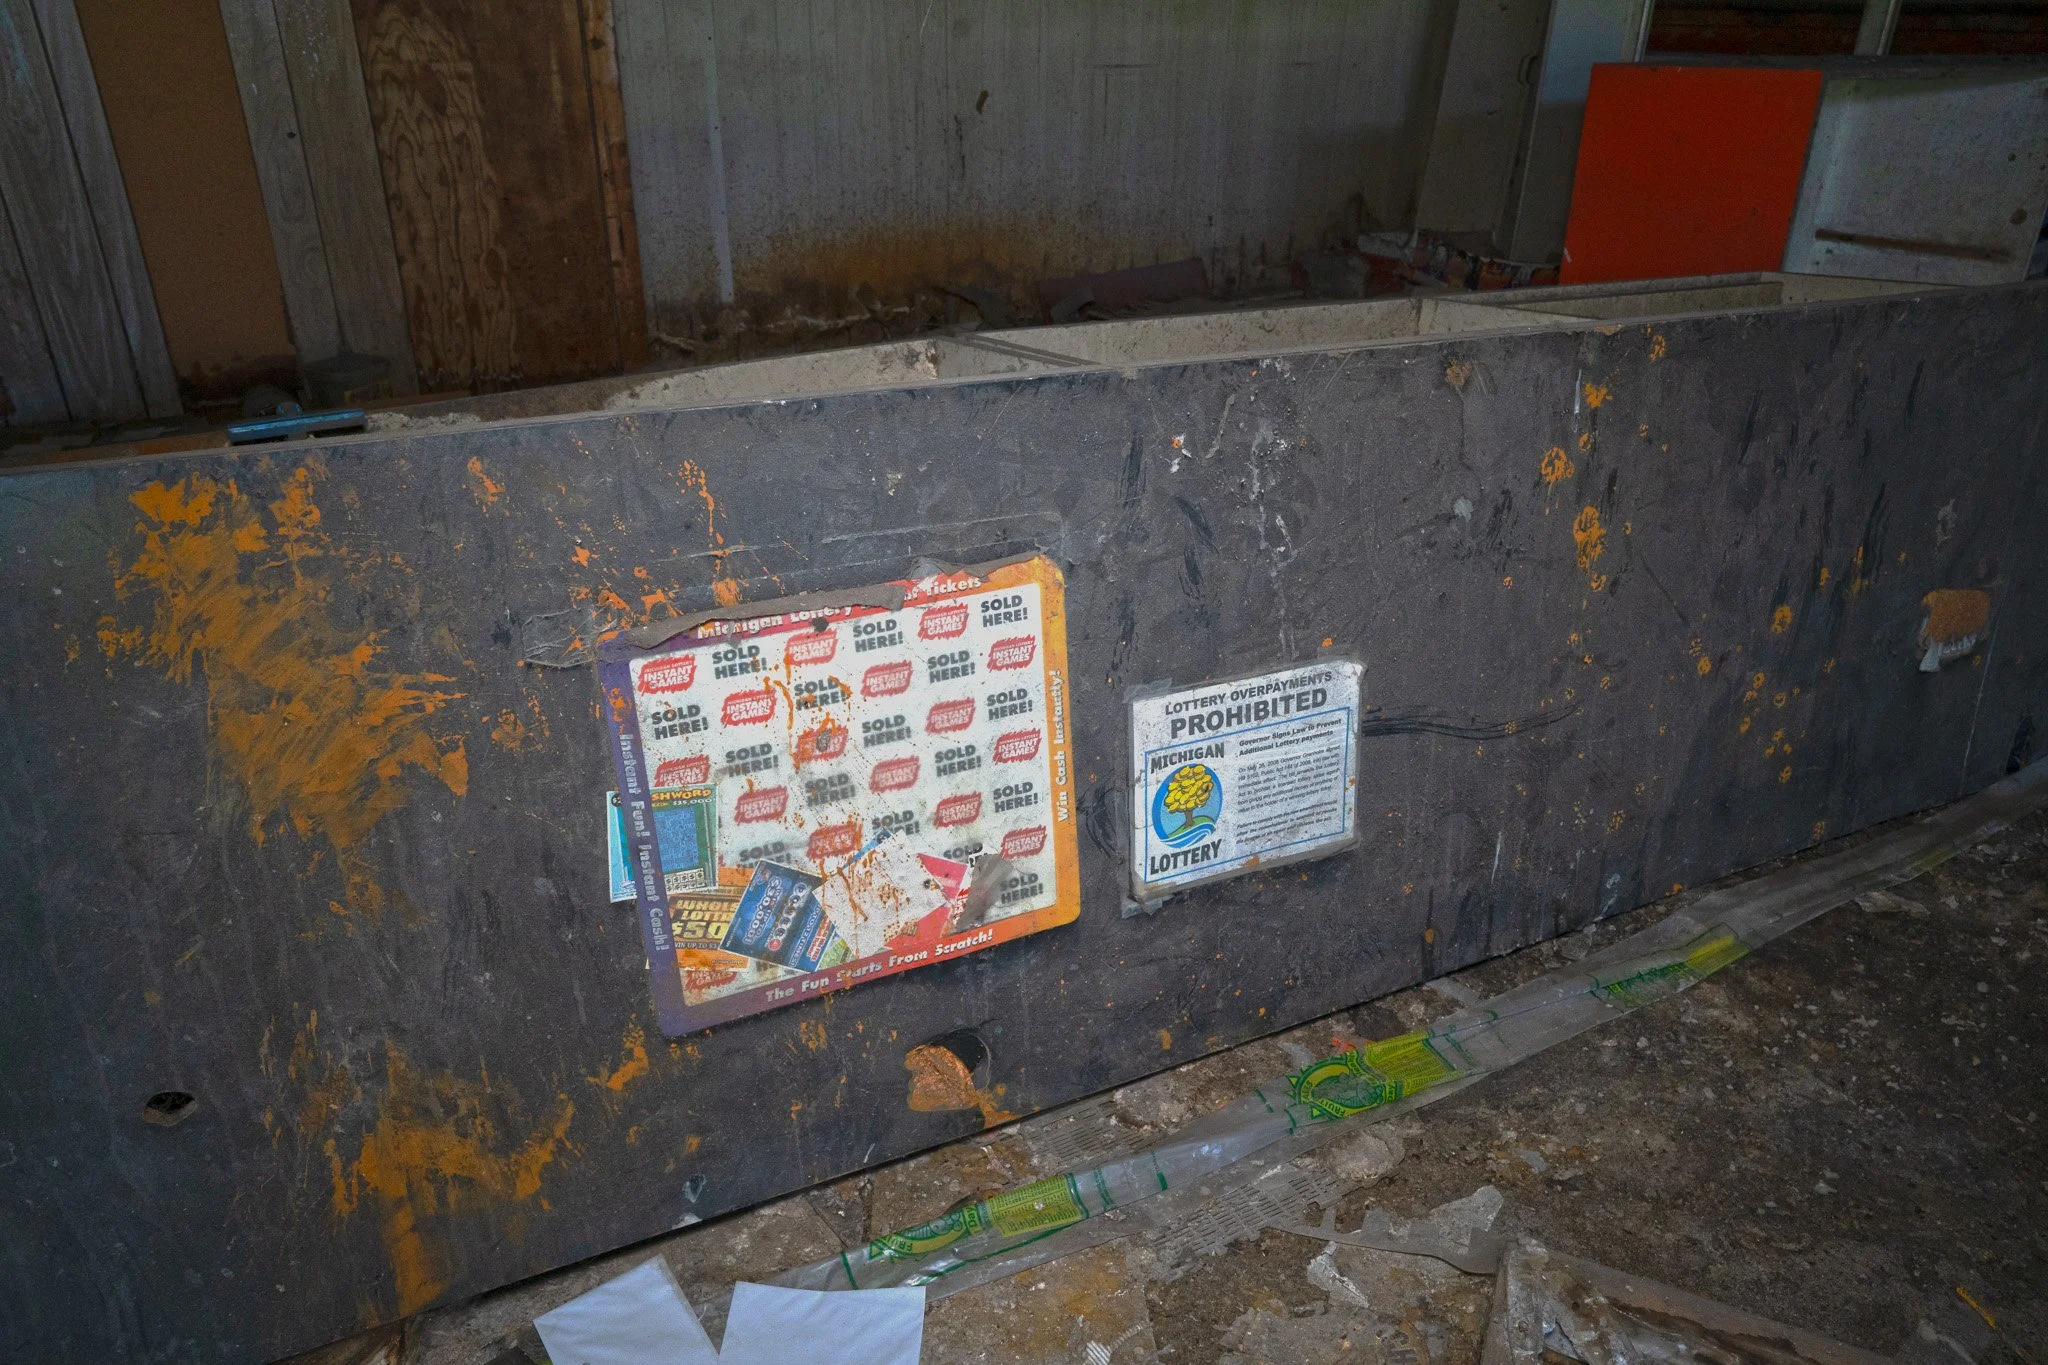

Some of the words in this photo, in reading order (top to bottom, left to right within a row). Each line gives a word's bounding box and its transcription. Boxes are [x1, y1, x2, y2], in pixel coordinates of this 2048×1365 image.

[981, 596, 1023, 613] SOLD
[923, 614, 964, 629] INSTANT
[983, 609, 1028, 628] HERE!
[853, 619, 898, 638] SOLD
[928, 621, 962, 636] GAMES
[790, 638, 835, 655] INSTANT
[855, 633, 904, 653] HERE!
[992, 645, 1031, 660] INSTANT
[712, 645, 761, 664] SOLD
[795, 646, 832, 662] GAMES
[928, 651, 971, 669] SOLD
[997, 652, 1029, 667] GAMES
[645, 666, 693, 683] INSTANT
[715, 660, 768, 680] HERE!
[865, 670, 907, 686] INSTANT
[930, 664, 976, 683] HERE!
[651, 674, 691, 690] GAMES
[795, 678, 840, 696] SOLD
[870, 678, 905, 693] GAMES
[988, 689, 1028, 707] SOLD
[1165, 693, 1226, 715] LOTTERY
[1230, 671, 1332, 701] OVERPAYMENTS
[652, 706, 701, 725] SOLD
[731, 706, 769, 722] GAMES
[931, 706, 971, 722] INSTANT
[989, 702, 1033, 721] HERE!
[1048, 670, 1066, 745] Instantly!
[1170, 687, 1328, 739] PROHIBITED
[655, 720, 709, 741] HERE!
[862, 716, 906, 734] SOLD
[936, 714, 969, 729] GAMES
[864, 729, 912, 748] HERE!
[1239, 734, 1270, 747] Governor
[1272, 730, 1290, 740] Signs
[1317, 719, 1342, 729] Prevent
[998, 737, 1036, 753] INSTANT
[1002, 744, 1034, 759] GAMES
[1239, 744, 1273, 756] Additional
[1276, 737, 1300, 749] Lottery
[1302, 730, 1333, 742] payments
[726, 744, 773, 763] SOLD
[935, 745, 977, 763] SOLD
[1150, 742, 1225, 774] MICHIGAN
[619, 734, 641, 795] Instant
[728, 757, 779, 778] HERE!
[937, 758, 982, 777] HERE!
[1054, 750, 1068, 786] Cash
[994, 782, 1033, 800] SOLD
[995, 794, 1038, 813] HERE!
[1056, 791, 1069, 823] Win
[631, 801, 651, 837] Fun!
[872, 811, 914, 830] SOLD
[943, 808, 975, 823] GAMES
[1005, 833, 1042, 849] INSTANT
[1009, 840, 1040, 855] GAMES
[1150, 839, 1222, 875] LOTTERY
[638, 844, 660, 902] Instant
[1000, 873, 1039, 891] SOLD
[1001, 885, 1043, 904] HERE!
[649, 907, 670, 951] Cash!
[765, 986, 795, 1003] The
[801, 977, 830, 993] Fun
[837, 962, 882, 983] Starts
[888, 950, 928, 968] From
[934, 929, 993, 956] Scratch!
